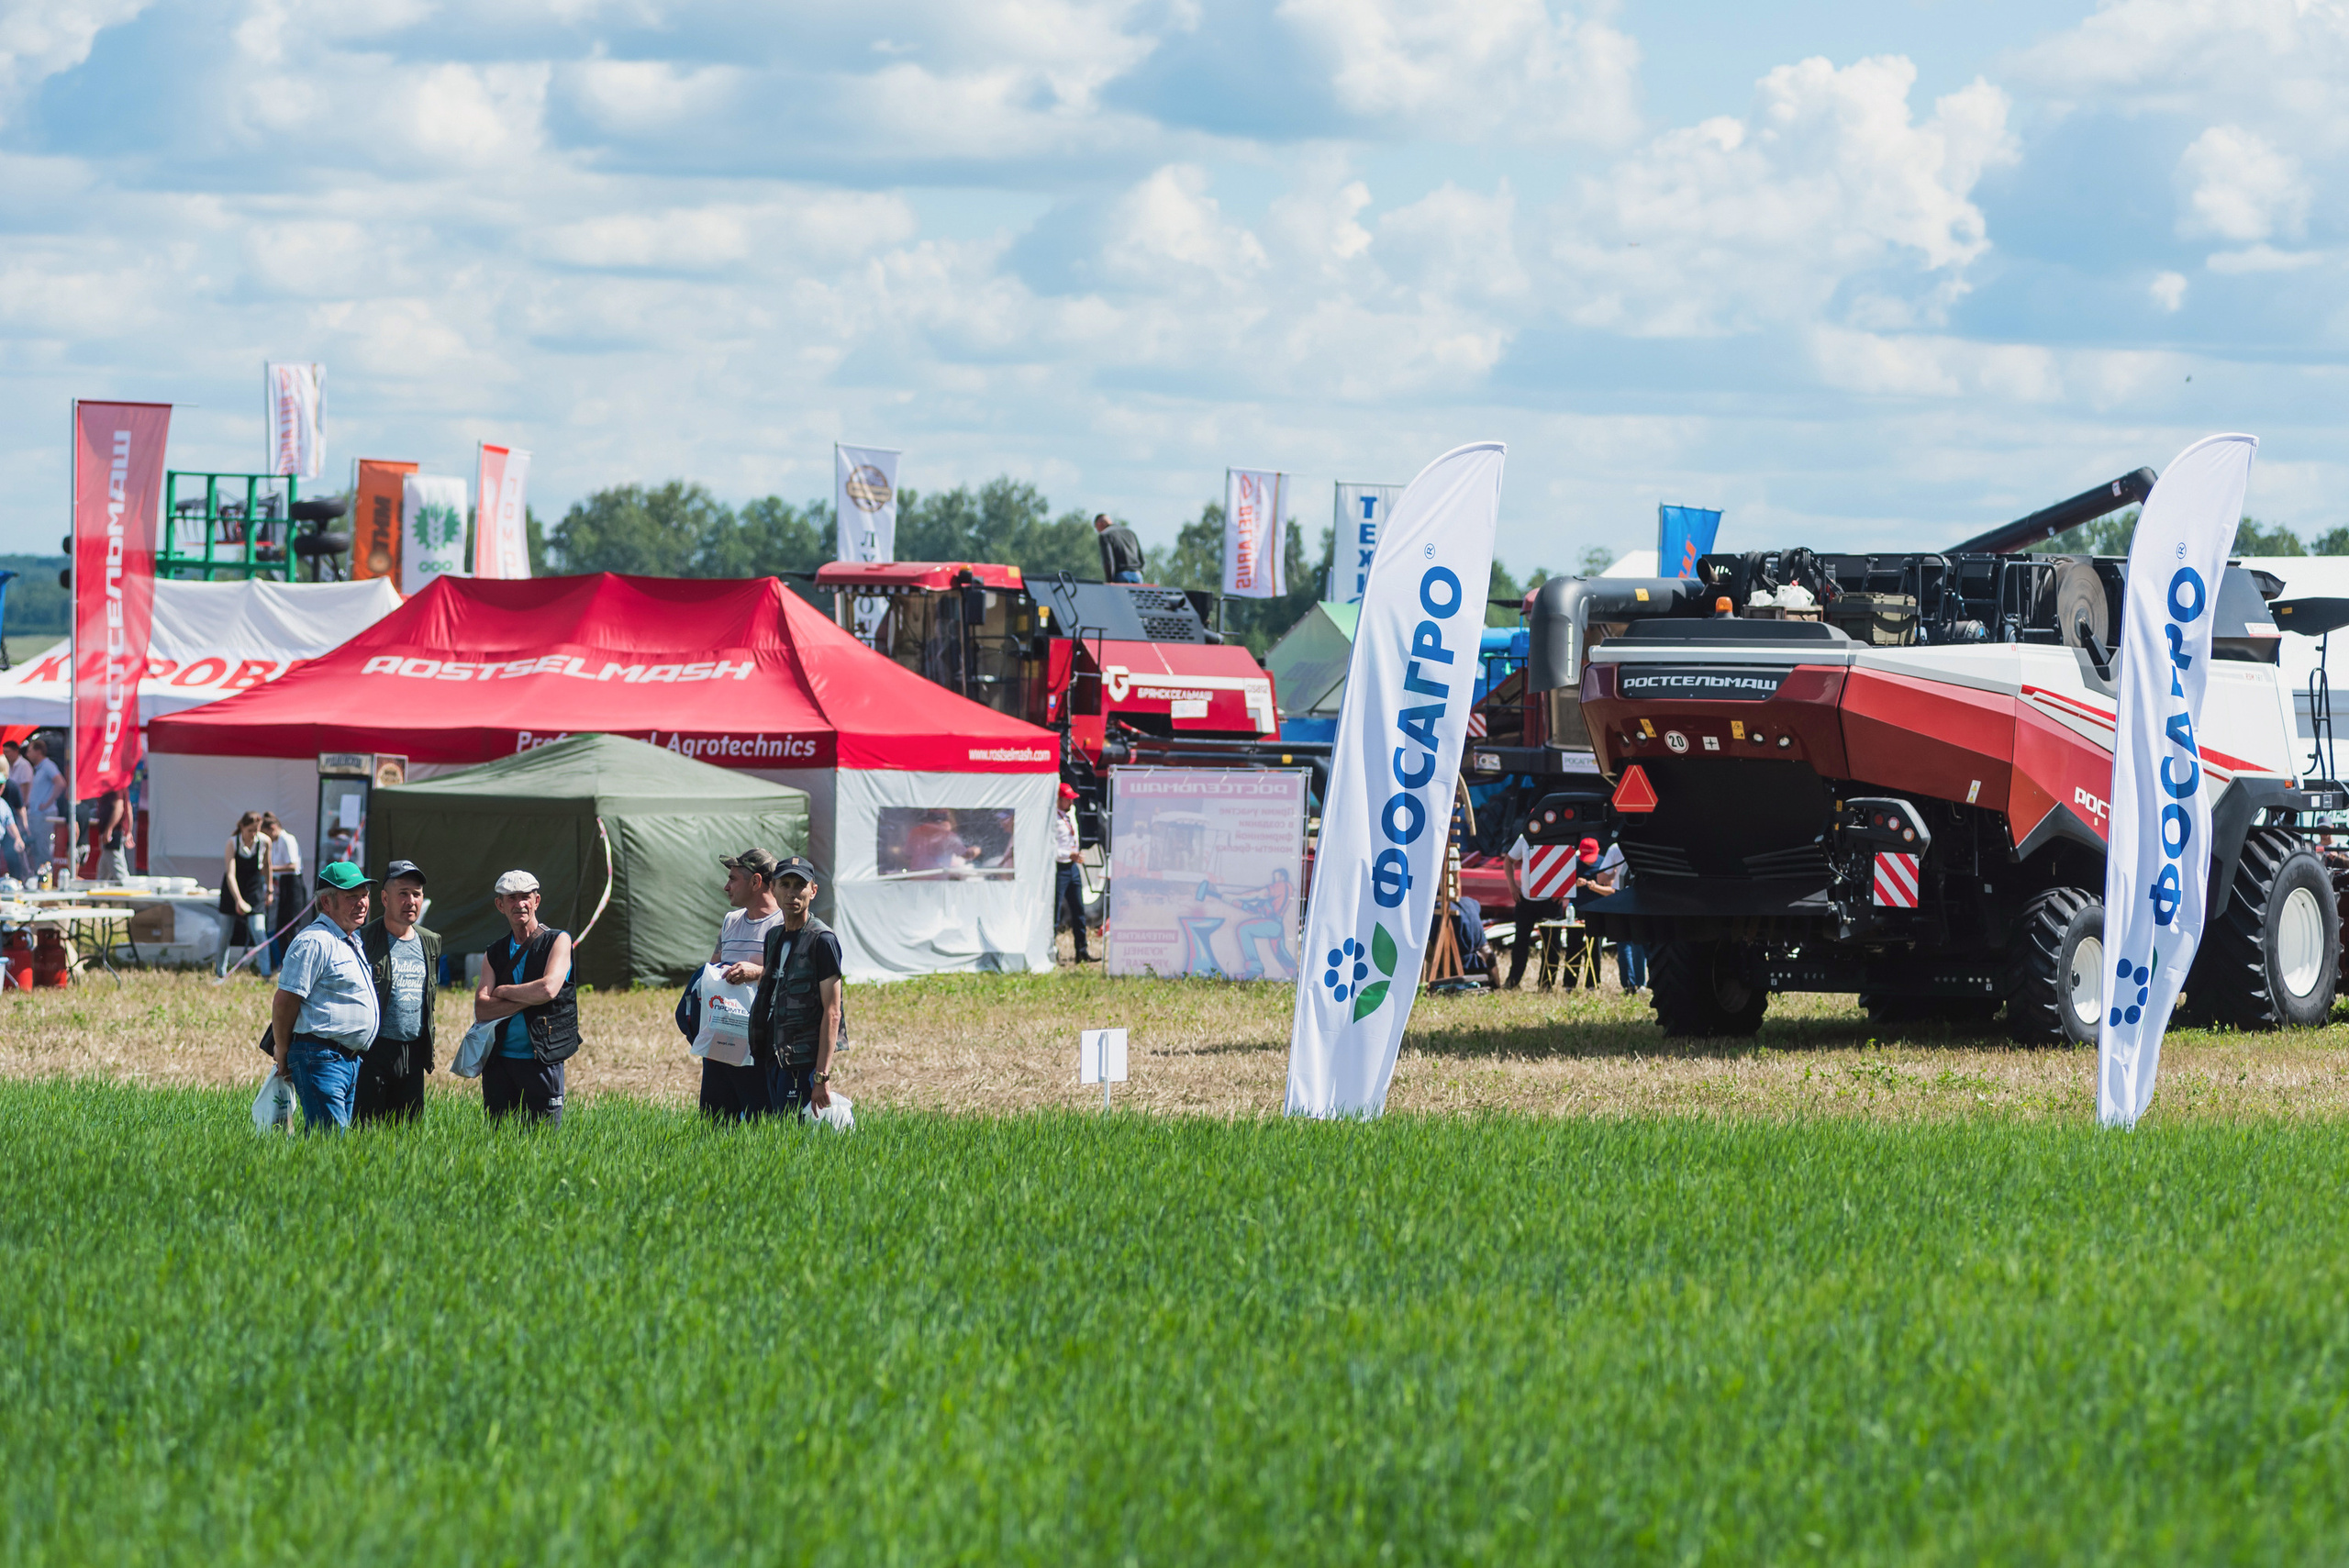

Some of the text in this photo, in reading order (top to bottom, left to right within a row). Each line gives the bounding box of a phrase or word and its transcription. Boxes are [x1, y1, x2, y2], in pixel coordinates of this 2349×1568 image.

[97, 429, 132, 773] РОСТСЕЛЬМАШ
[361, 654, 755, 684] ROSTSELMASH
[1623, 675, 1777, 691] РОСТСЕЛЬМАШ
[1137, 687, 1213, 702] БРЯНСКСЕЛЬМАШ
[667, 733, 817, 758] Agrotechnics
[1372, 566, 1463, 908] ФОСАГРО
[1668, 735, 1685, 748] 20
[968, 746, 1052, 762] www.rostselmash.com
